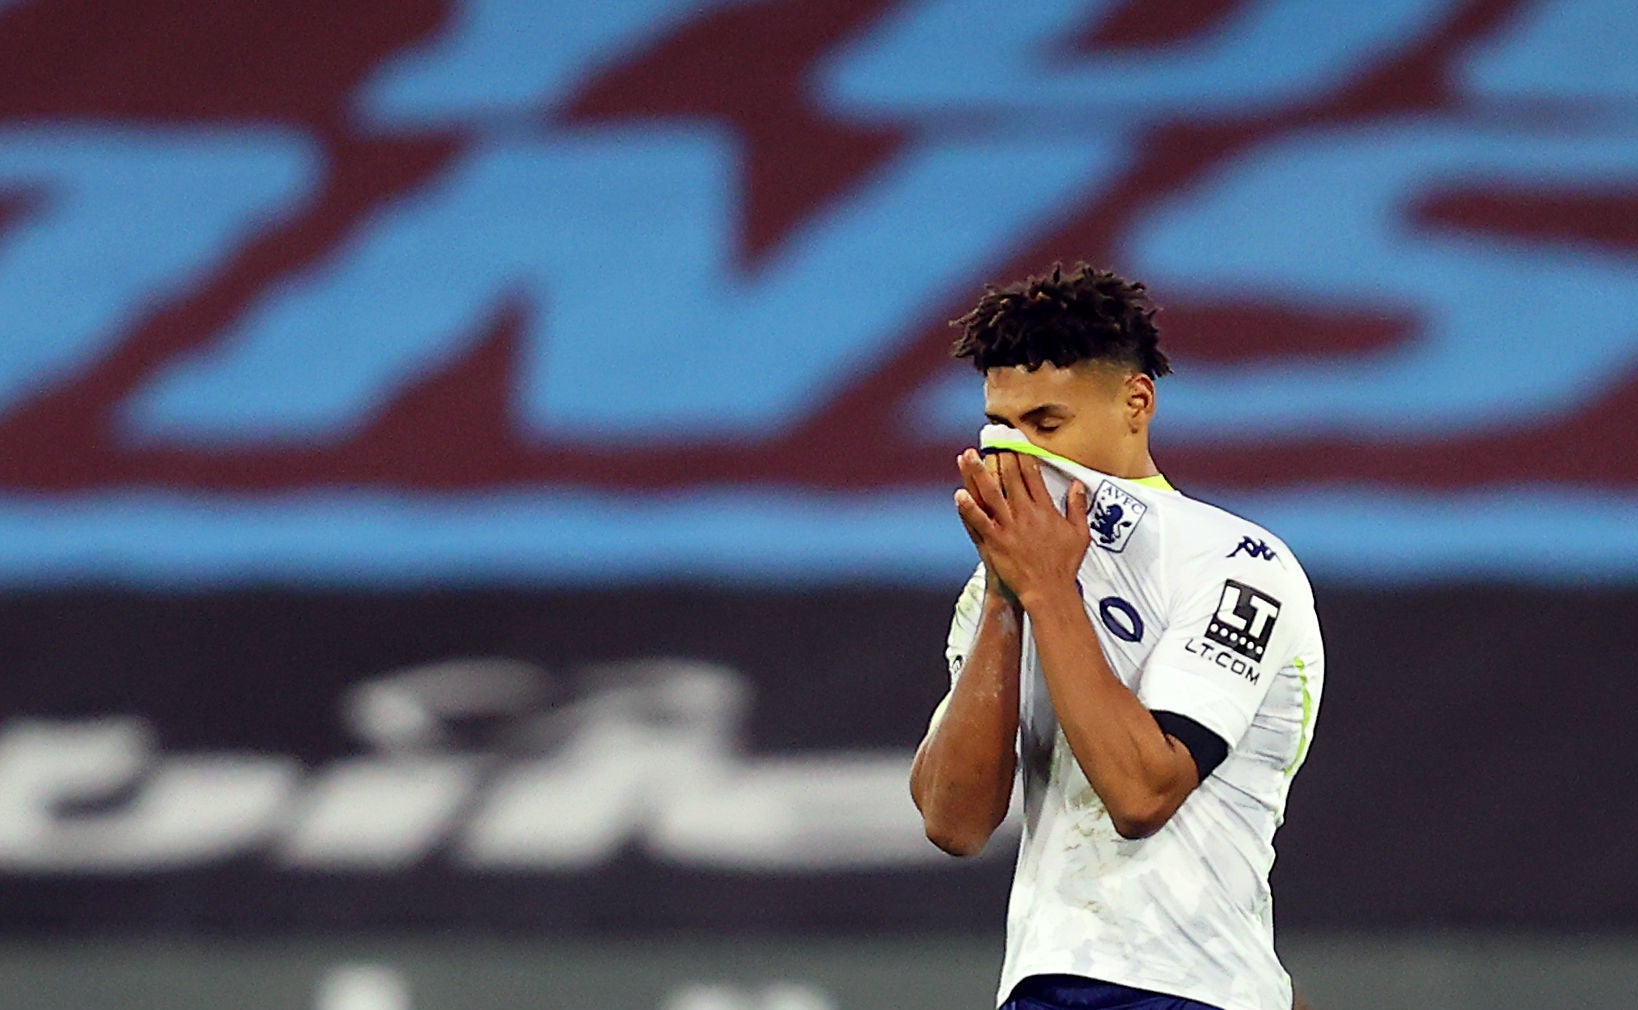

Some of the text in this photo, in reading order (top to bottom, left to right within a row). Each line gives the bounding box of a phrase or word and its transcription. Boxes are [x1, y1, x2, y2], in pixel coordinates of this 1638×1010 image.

[1102, 485, 1143, 515] AVFC
[1217, 585, 1279, 639] LT
[1184, 638, 1261, 686] LT.COM
